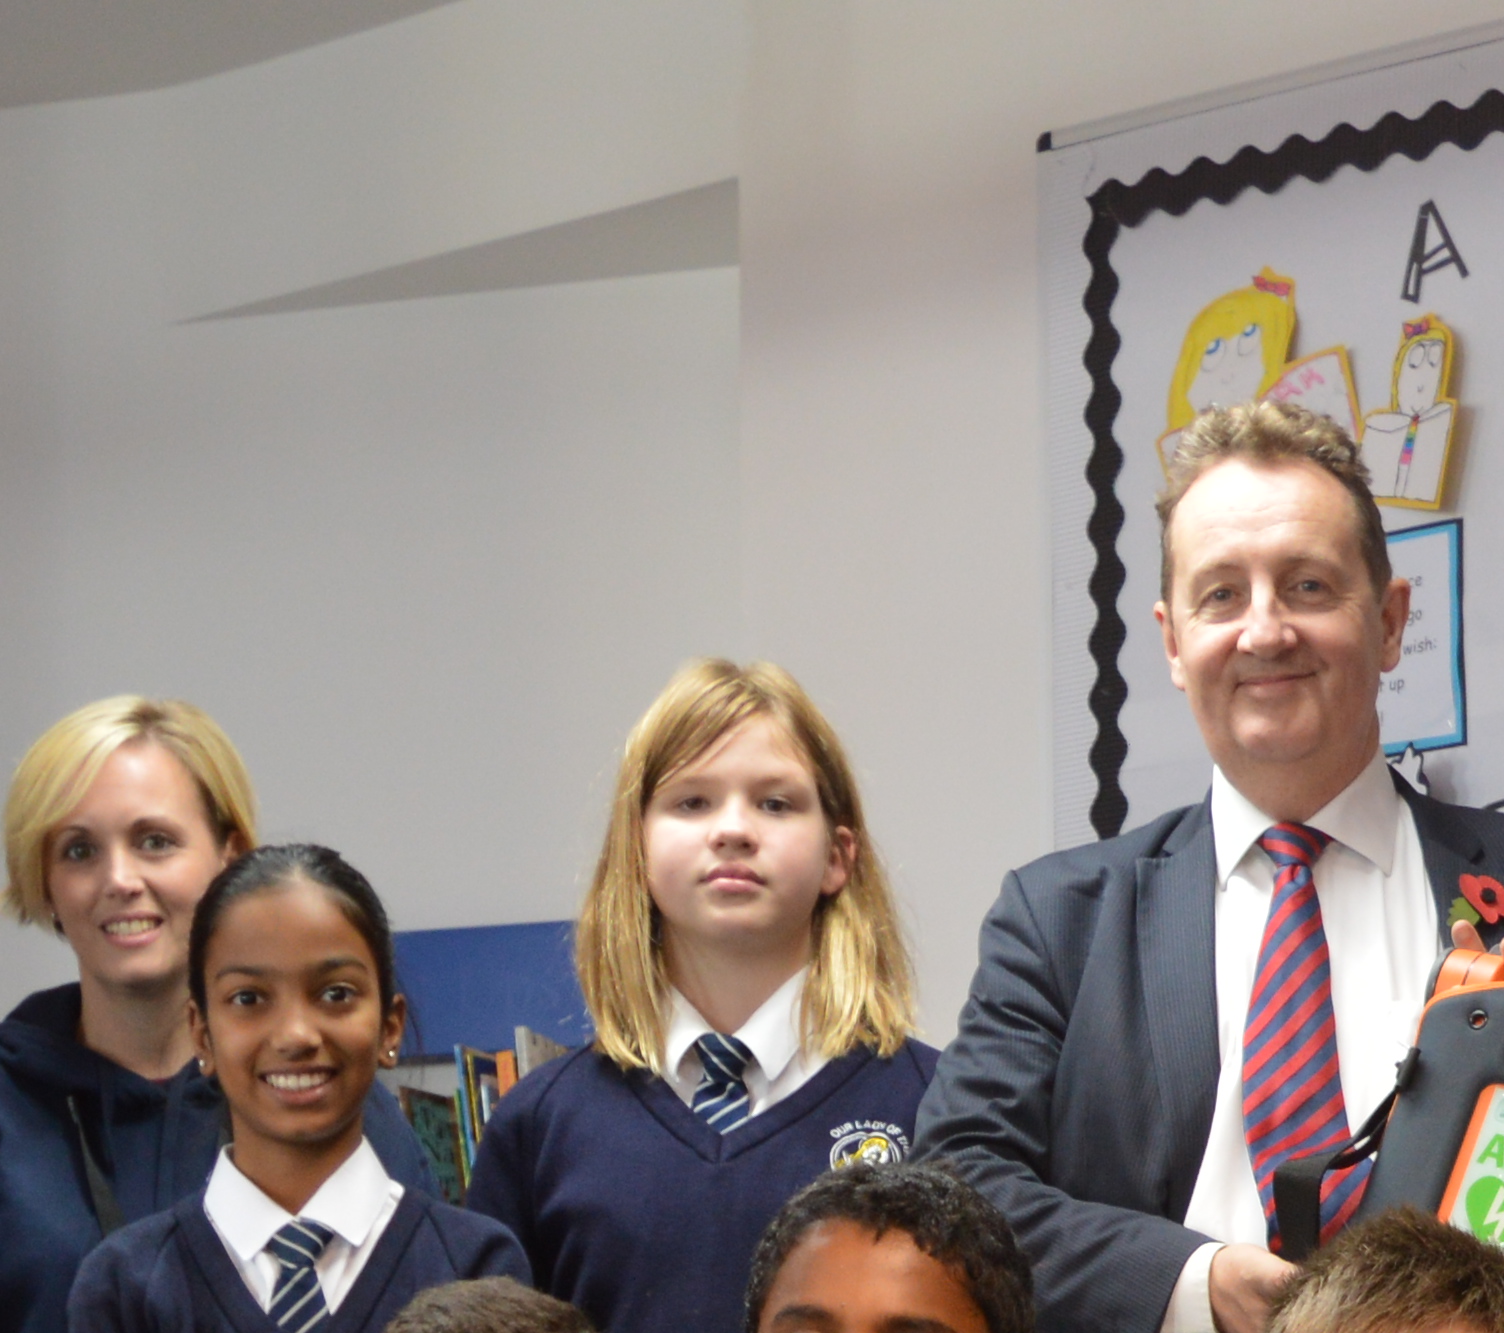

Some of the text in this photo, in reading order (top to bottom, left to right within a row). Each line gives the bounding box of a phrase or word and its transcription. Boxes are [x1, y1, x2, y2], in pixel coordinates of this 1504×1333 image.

[1401, 200, 1470, 303] A
[1389, 678, 1405, 695] up
[830, 1122, 854, 1138] OUR
[855, 1120, 887, 1130] LADY
[886, 1124, 902, 1135] OF
